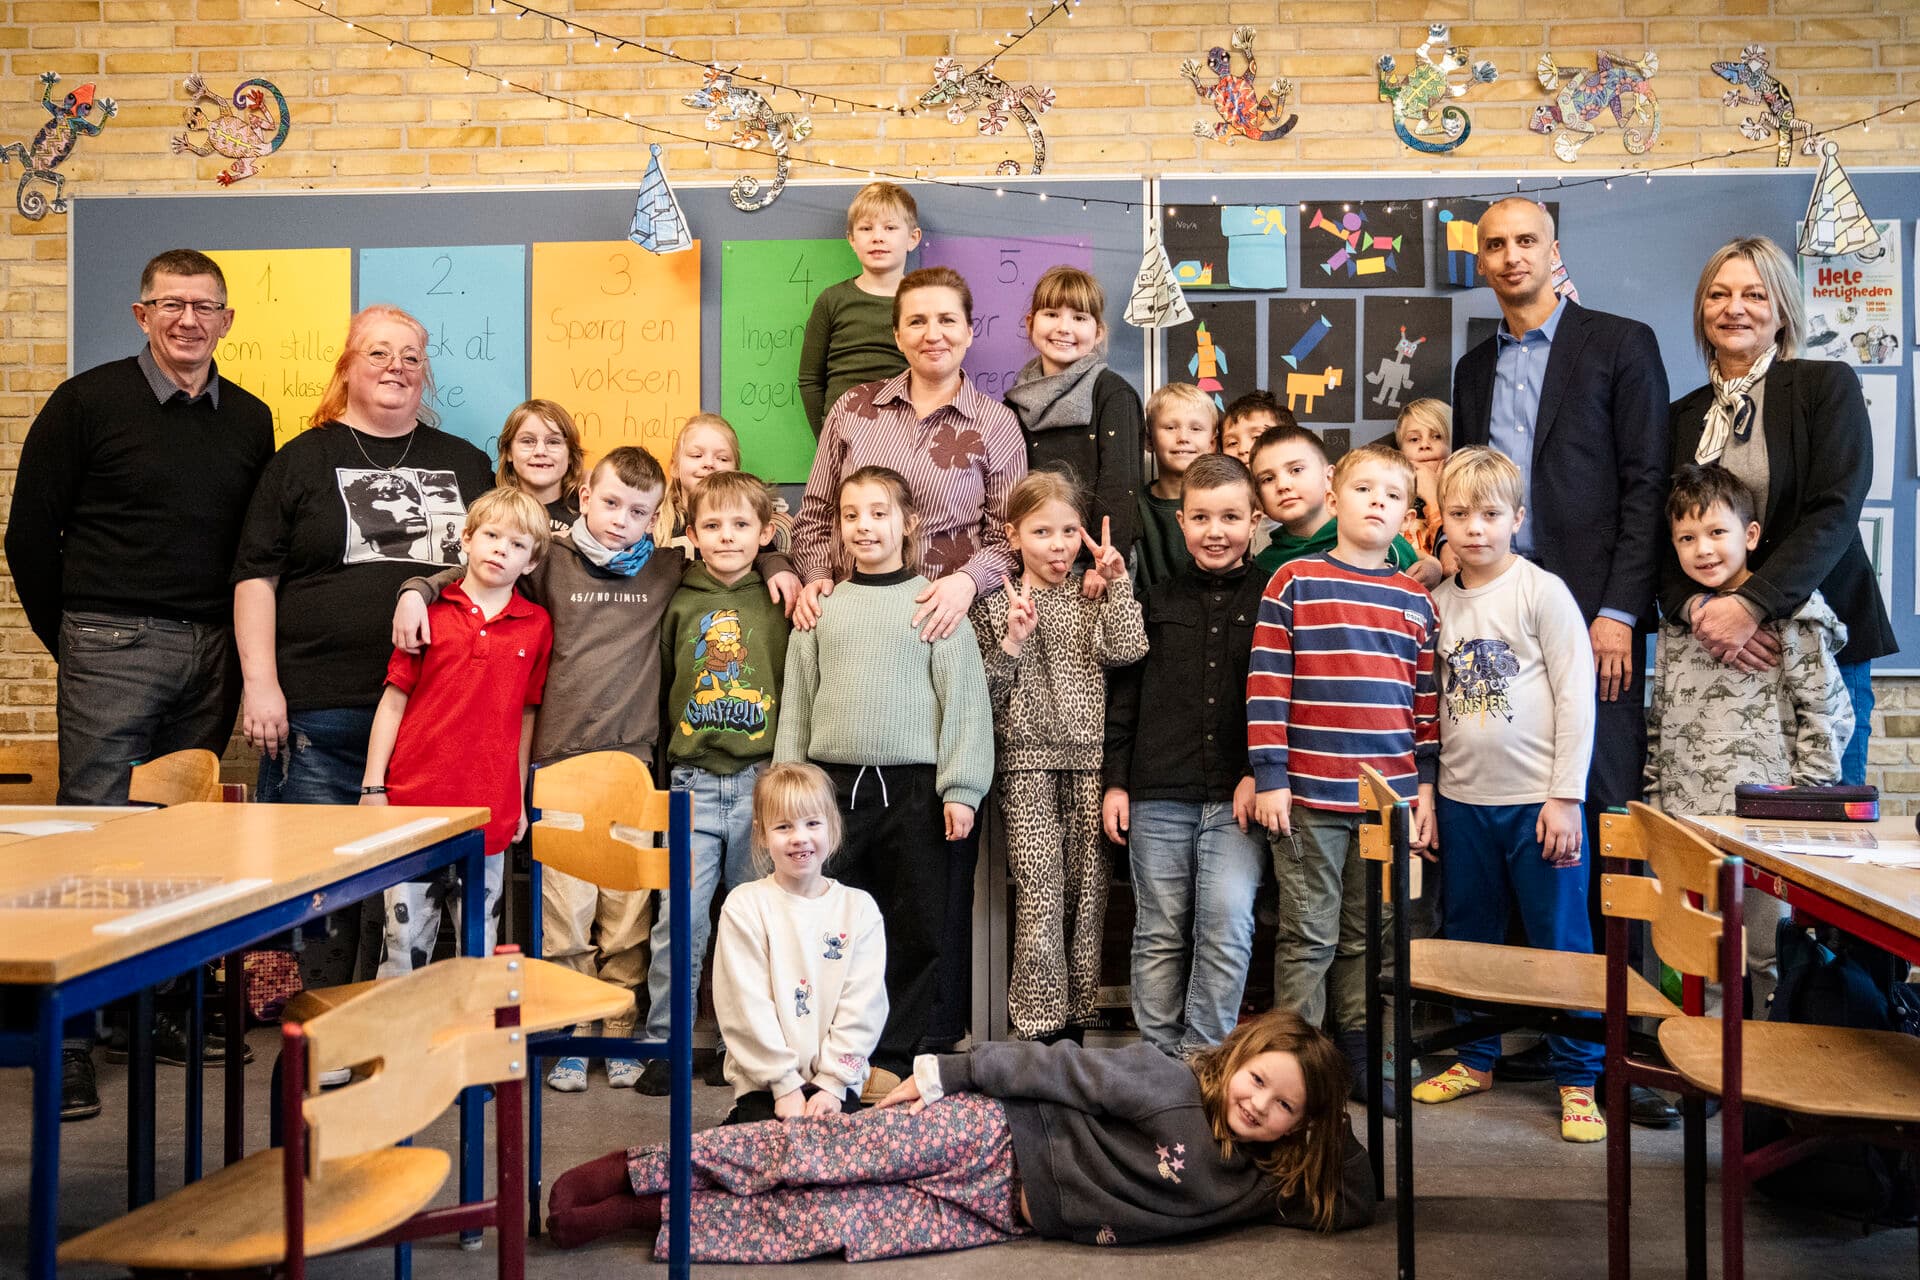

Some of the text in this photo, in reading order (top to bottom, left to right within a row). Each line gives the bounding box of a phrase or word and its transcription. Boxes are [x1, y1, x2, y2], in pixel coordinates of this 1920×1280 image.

[257, 264, 278, 303] 1.
[426, 255, 466, 296] 2.
[600, 253, 637, 297] 3.
[788, 254, 814, 305] 4
[997, 250, 1025, 286] 5.
[1818, 268, 1863, 286] Hele
[1813, 286, 1893, 303] herligheden
[279, 330, 341, 363] stille
[465, 316, 497, 361] at
[546, 307, 675, 356] Spørg en
[571, 358, 681, 395] voksen
[574, 411, 602, 439] m
[597, 592, 610, 602] NO
[614, 593, 648, 603] LIMITS
[685, 699, 765, 731] GARFIELD
[1424, 1078, 1451, 1093] UCK
